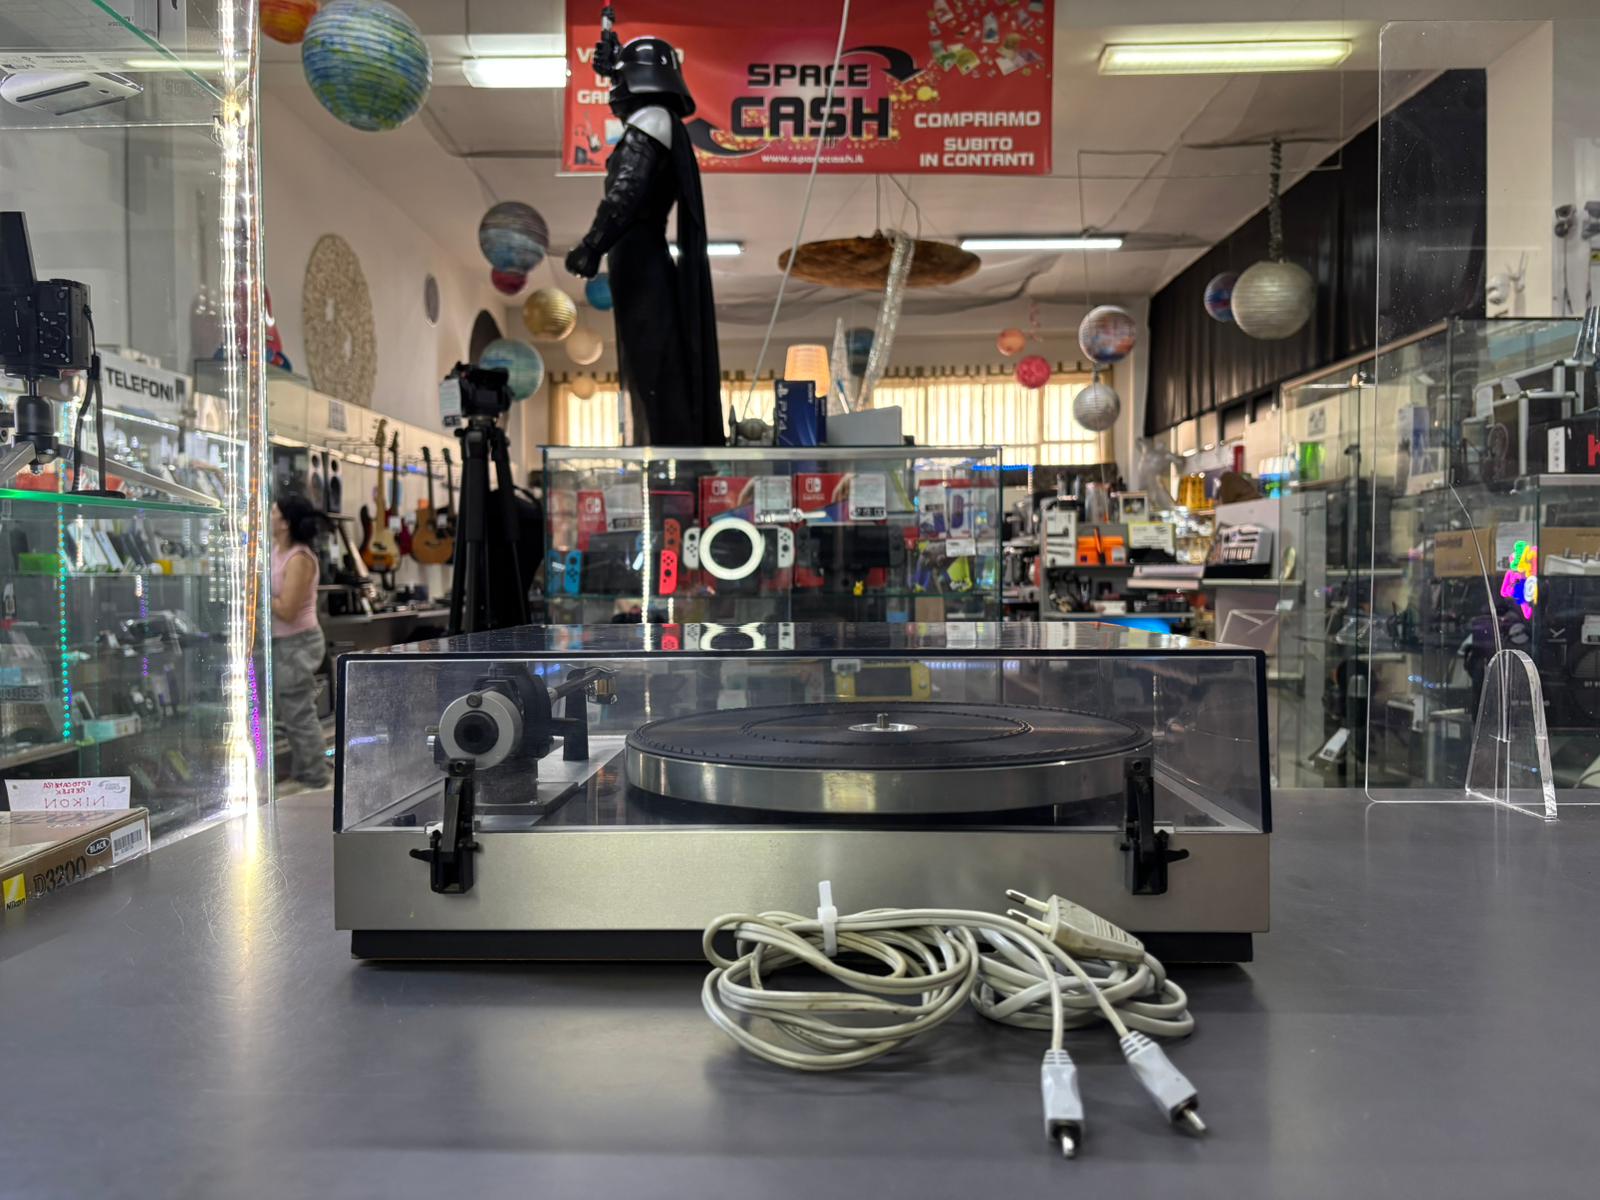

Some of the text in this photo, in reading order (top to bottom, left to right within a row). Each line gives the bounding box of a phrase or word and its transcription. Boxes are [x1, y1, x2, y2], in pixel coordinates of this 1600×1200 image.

[747, 63, 869, 87] SPACE
[731, 97, 890, 137] CASH
[914, 111, 1041, 128] COMPRIAMO
[944, 137, 1013, 151] SUBITO
[919, 152, 1035, 167] IN CONTANTI
[105, 367, 174, 402] TELEFONI
[89, 839, 108, 853] BLACK
[32, 855, 87, 896] D3200
[6, 898, 26, 911] Nikon
